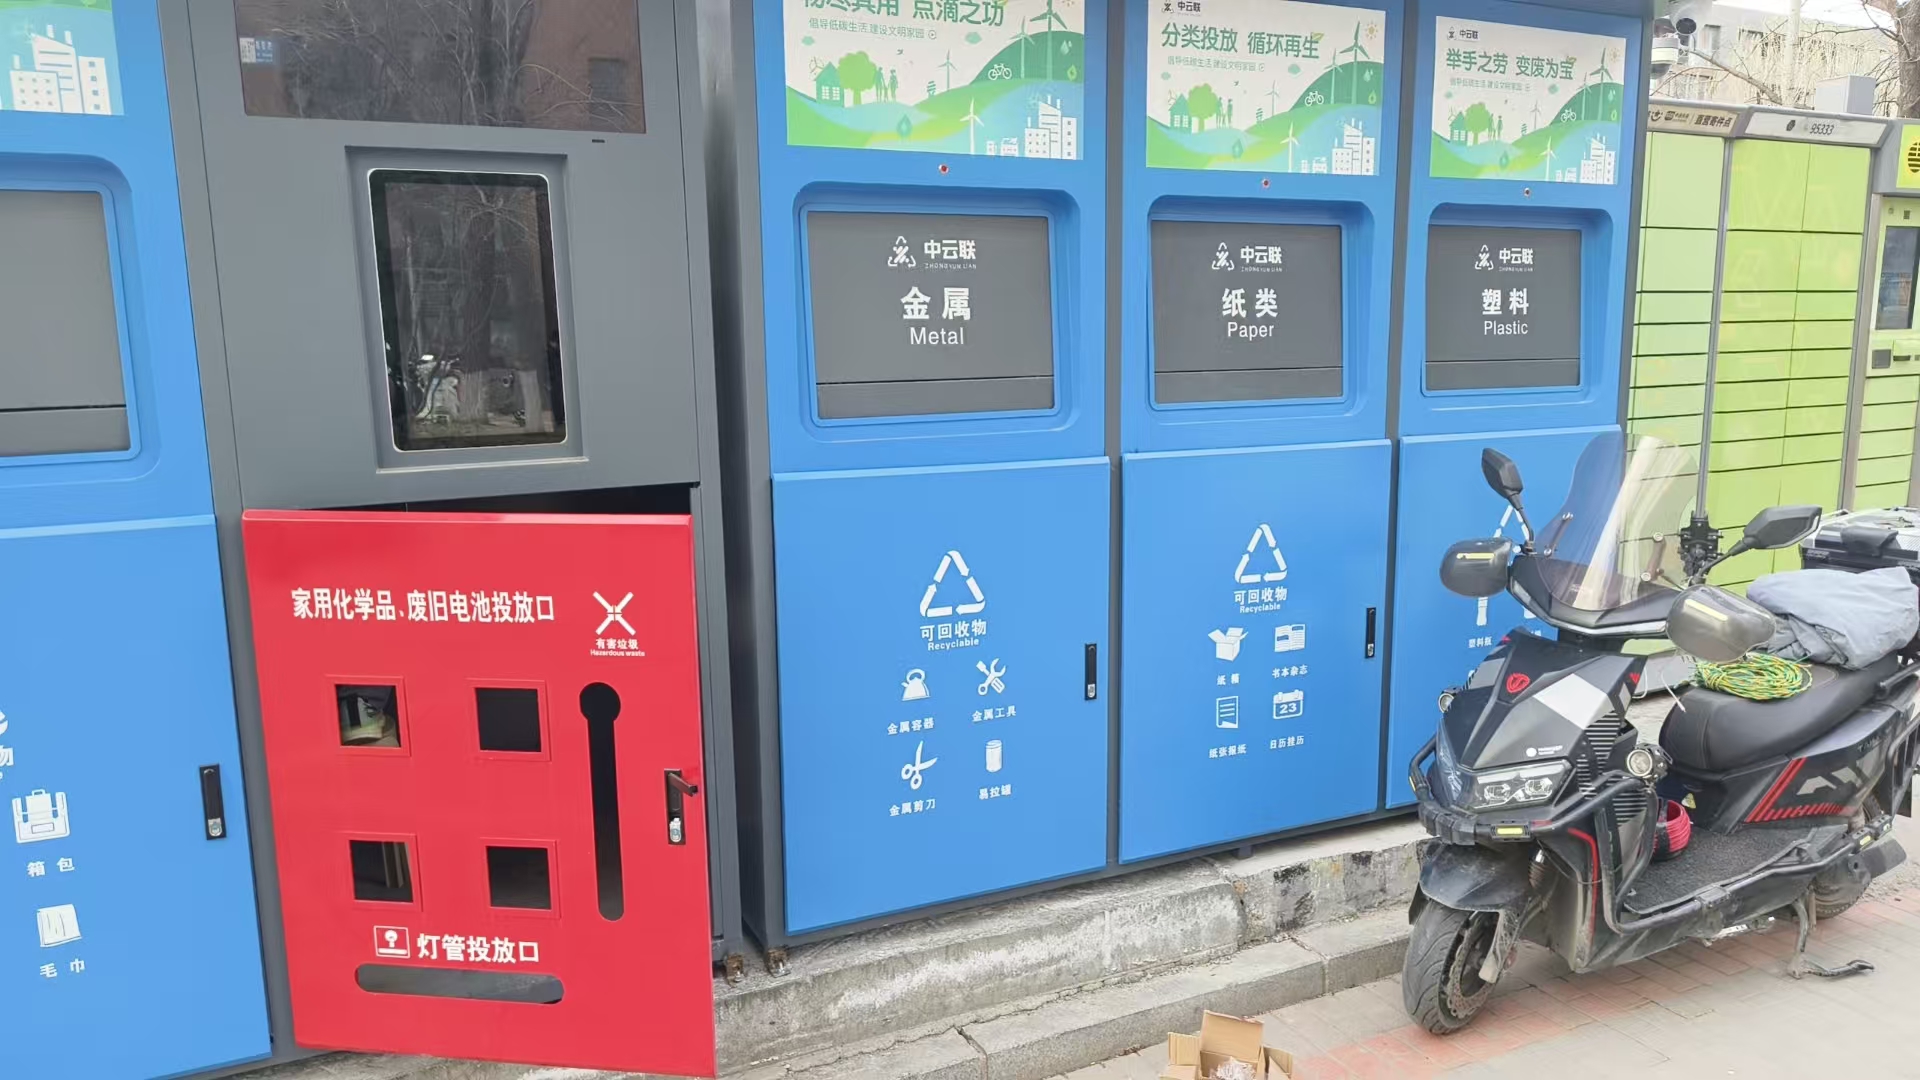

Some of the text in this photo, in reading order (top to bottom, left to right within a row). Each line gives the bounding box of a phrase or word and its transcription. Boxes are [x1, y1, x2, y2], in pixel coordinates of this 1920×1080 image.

[913, 0, 1004, 26] 点滴之功
[1177, 1, 1201, 12] 中云联
[1161, 22, 1319, 59] 分类投放 循环再生
[1446, 48, 1574, 80] 举手之劳 变废为宝
[924, 239, 976, 259] 中云联
[1240, 245, 1282, 264] 中云联
[1499, 247, 1533, 264] 中云联
[900, 286, 971, 320] 金属
[1222, 288, 1278, 318] 纸类
[1482, 288, 1529, 315] 塑料
[910, 326, 964, 345] Metal
[1227, 322, 1275, 341] Paper
[1484, 320, 1529, 335] Plastic
[1234, 586, 1288, 605] 可回收物
[1239, 602, 1281, 614] Recyclable
[919, 619, 987, 642] 可回收物
[596, 638, 638, 650] 有害垃圾
[927, 637, 979, 651] Recyclable
[1272, 664, 1308, 679] 书本杂志
[972, 705, 1016, 722] 金属工具
[1279, 703, 1297, 714] 23
[887, 717, 935, 735] 金属容器
[1209, 744, 1247, 759] 纸张报纸
[1270, 735, 1304, 750] 日历挂历
[979, 783, 1012, 800] 易拉罐
[889, 798, 936, 817] 金属剪刀
[27, 857, 75, 877] 箱包
[416, 933, 539, 963] 灯管投放口
[40, 958, 85, 978] 毛巾
